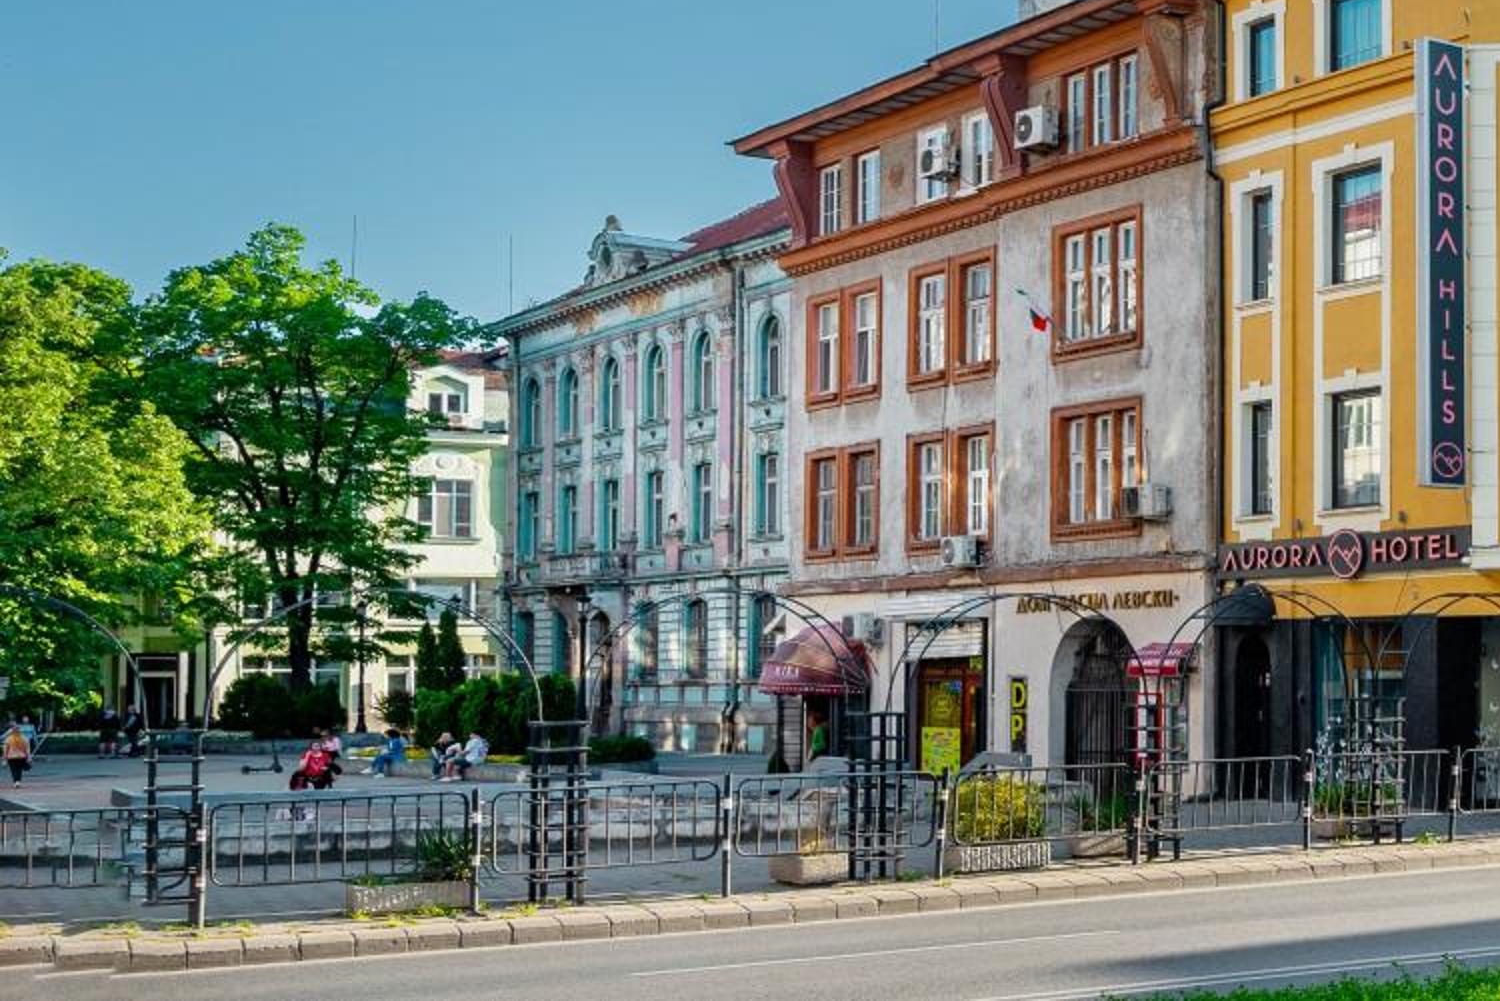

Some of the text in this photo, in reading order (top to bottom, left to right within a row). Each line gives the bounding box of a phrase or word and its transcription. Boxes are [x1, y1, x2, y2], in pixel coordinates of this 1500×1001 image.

[1434, 53, 1458, 424] AURORA HILLS
[1223, 534, 1460, 571] AURORA HOTEL
